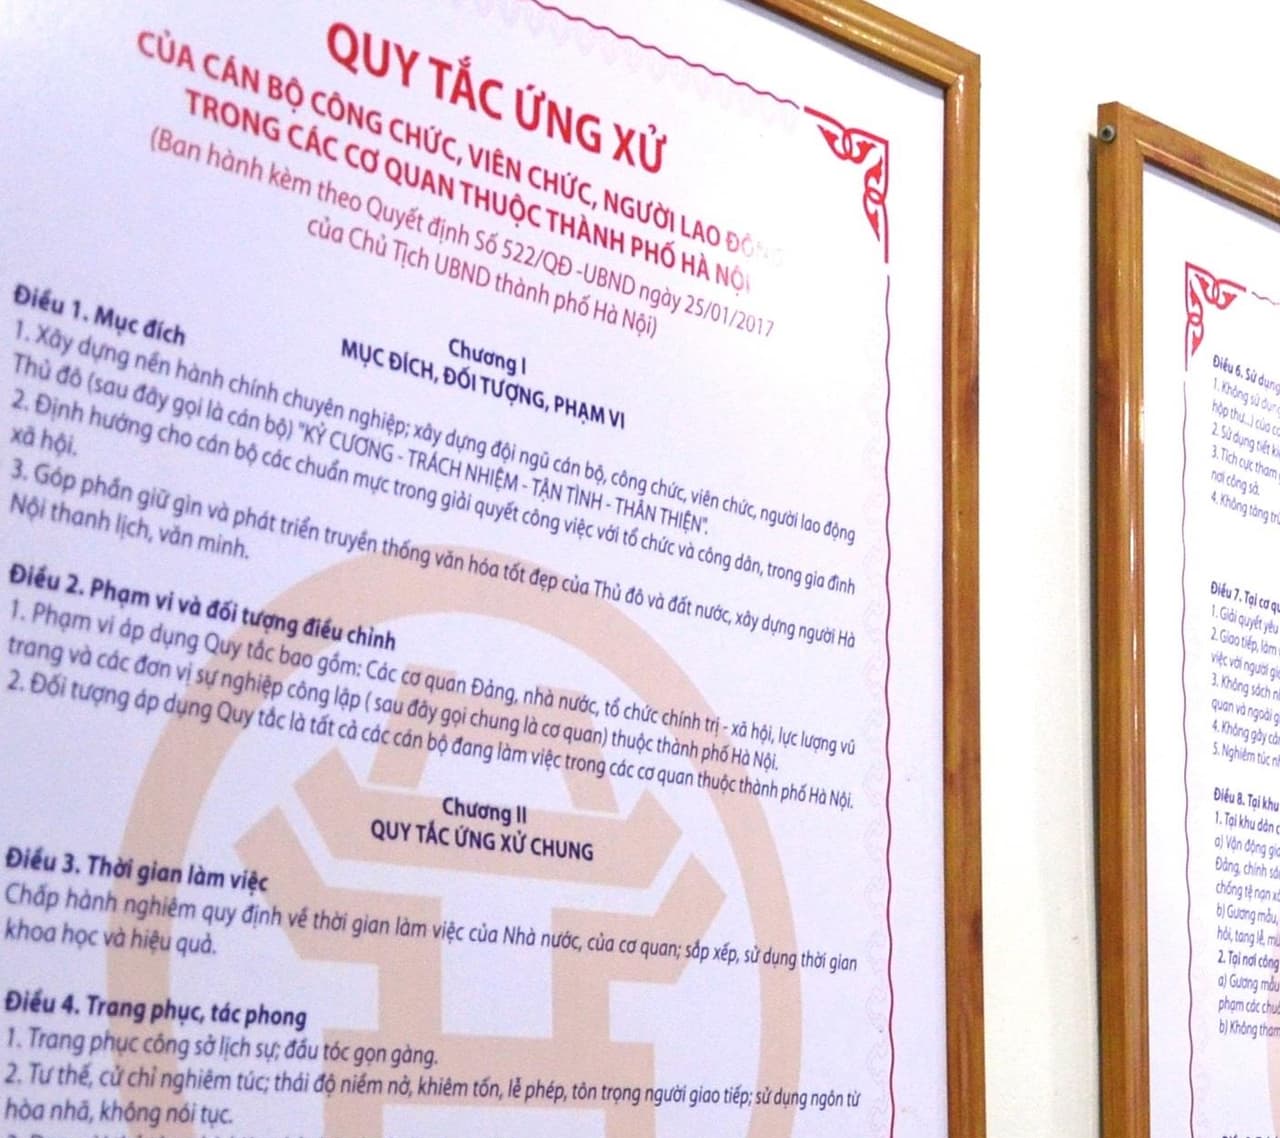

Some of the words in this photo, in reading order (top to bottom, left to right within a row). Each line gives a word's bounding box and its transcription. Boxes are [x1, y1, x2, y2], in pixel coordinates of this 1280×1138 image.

[326, 21, 421, 89] QUY
[427, 54, 505, 122] TẮC
[514, 82, 602, 155] ỨNG
[611, 121, 668, 175] XỬ
[136, 28, 196, 73] CỦA
[201, 52, 260, 95] CÁN
[266, 73, 305, 114] BỘ
[309, 89, 383, 137] CÔNG
[387, 117, 463, 167] CHỨC,
[467, 142, 522, 184] VIÊN
[526, 164, 598, 211] CHỨC,
[602, 187, 675, 234] NGƯỜI
[679, 213, 721, 248] LAO
[184, 87, 281, 143] TRONG
[286, 123, 339, 163] CÁC
[343, 142, 381, 175] CƠ
[383, 155, 455, 201] QUAN
[458, 179, 542, 229] THUỘC
[544, 206, 626, 255] THÀNH
[630, 234, 677, 270] PHỐ
[680, 250, 711, 282] HÀ
[149, 125, 202, 163] (Ban
[205, 141, 264, 182] hành
[267, 161, 312, 197] kèm
[316, 179, 363, 213] theo
[365, 194, 425, 234] Quyết
[426, 215, 471, 247] định
[473, 228, 499, 256] Số
[637, 283, 683, 315] ngày
[683, 293, 775, 338] 25/01/2017
[306, 215, 345, 245] của
[347, 225, 388, 258] Chủ
[392, 237, 430, 271] Tịch
[433, 251, 492, 288] UBND
[493, 271, 551, 307] thành
[551, 289, 592, 318] phố
[591, 298, 619, 326] Hà
[620, 307, 658, 340] Nội)
[71, 298, 89, 323] 1.
[92, 304, 139, 335] Mục
[141, 317, 187, 347] đích
[340, 337, 385, 368] MỤC
[387, 350, 439, 385] ĐÍCH,
[441, 365, 477, 393] ĐỐI
[479, 374, 550, 413] TƯỢNG,
[553, 393, 606, 426] PHẠM
[607, 407, 625, 431] VI
[447, 336, 518, 378] Chương
[520, 355, 527, 376] I
[64, 572, 85, 596] 2.
[88, 576, 151, 609] Phạm
[154, 590, 175, 613] vi
[177, 594, 203, 617] và
[205, 598, 239, 623] đối
[240, 606, 300, 639] tượng
[345, 623, 397, 652] chỉnh
[369, 817, 412, 842] QUY
[414, 818, 451, 847] TẮC
[453, 823, 497, 852] ỨNG
[499, 828, 528, 855] XỬ
[528, 835, 594, 862] CHUNG
[441, 795, 513, 828] Chương
[515, 803, 528, 825] II
[60, 851, 81, 875] 3.
[86, 853, 134, 880] Thời
[136, 859, 183, 888] gian
[186, 862, 226, 889] làm
[229, 869, 269, 897] việc
[59, 993, 81, 1016] 4.
[86, 993, 147, 1025] Trang
[148, 997, 206, 1027] phục,
[210, 1000, 242, 1025] tác
[243, 1002, 308, 1033] phong
[6, 1025, 22, 1049] 1.
[27, 1025, 86, 1057] Trang
[87, 1028, 140, 1057] phục
[141, 1031, 191, 1062] công
[193, 1032, 218, 1057] sở
[217, 1033, 252, 1062] lịch
[254, 1040, 282, 1064] sự;
[282, 1036, 320, 1061] đầu
[322, 1039, 351, 1063] tóc
[352, 1045, 388, 1068] gọn
[389, 1043, 439, 1071] gàng.
